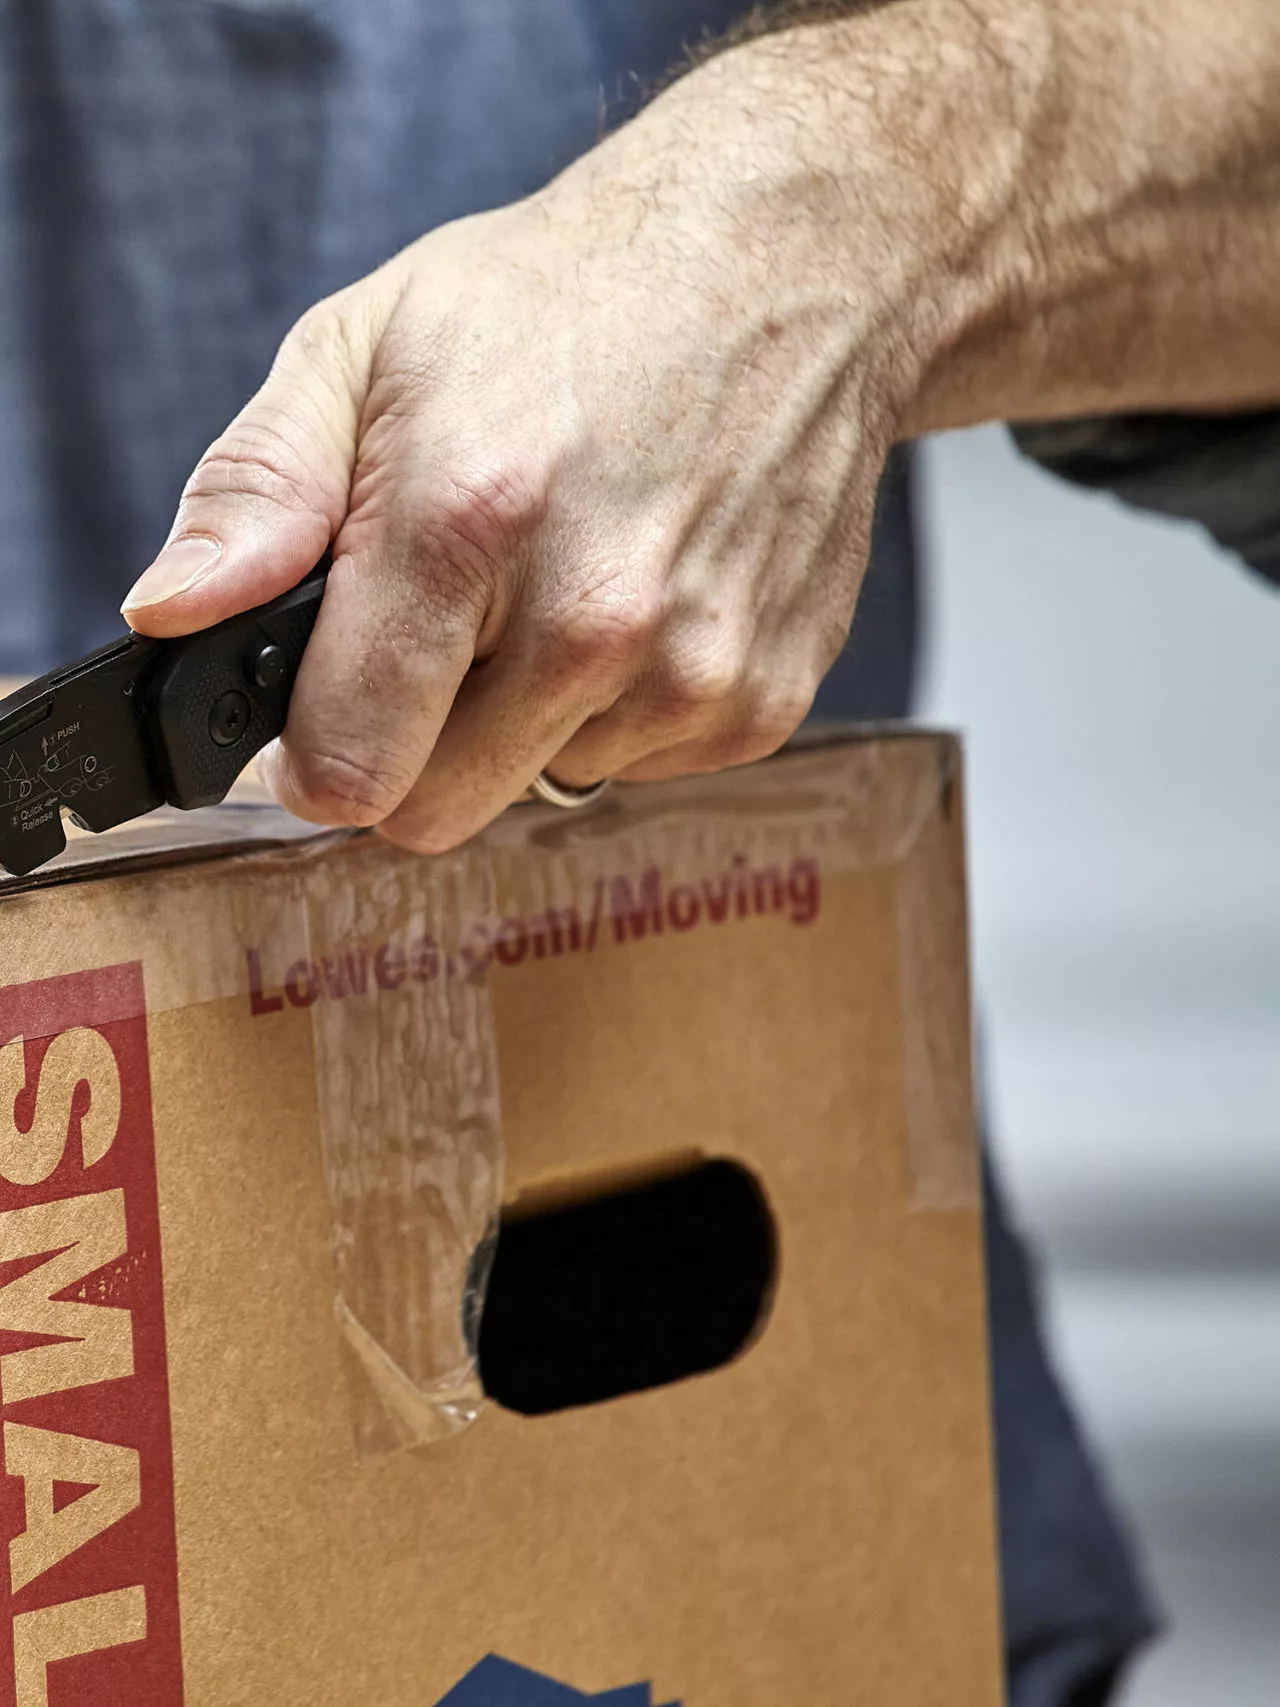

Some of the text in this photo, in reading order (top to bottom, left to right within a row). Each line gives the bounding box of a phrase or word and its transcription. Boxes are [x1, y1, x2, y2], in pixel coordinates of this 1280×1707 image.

[57, 721, 80, 741] PUSH
[20, 802, 44, 821] Quick
[21, 811, 54, 833] Release
[245, 853, 821, 1016] Lowes.com/Moving
